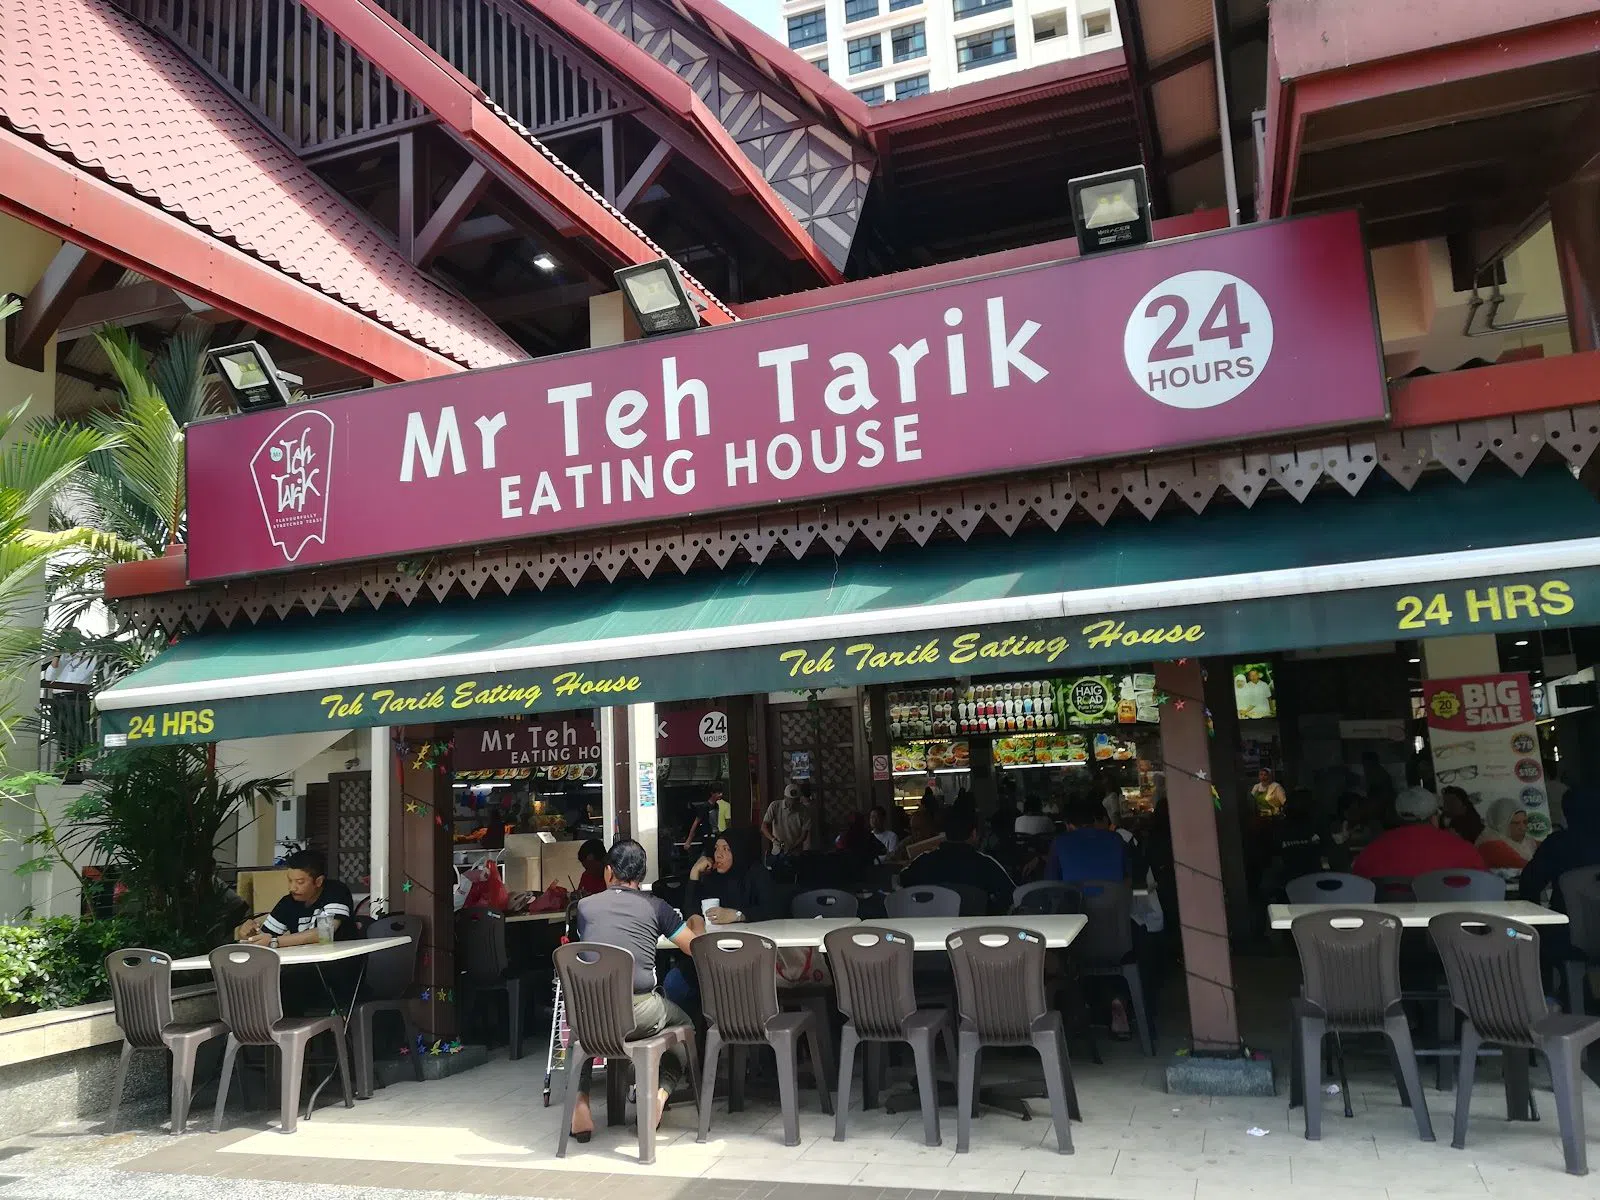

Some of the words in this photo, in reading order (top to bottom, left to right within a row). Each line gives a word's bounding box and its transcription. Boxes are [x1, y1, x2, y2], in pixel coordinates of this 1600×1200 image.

[1144, 282, 1251, 363] 24
[399, 405, 508, 482] Mr
[547, 356, 711, 457] Teh
[757, 295, 1050, 424] Tarik
[1147, 356, 1255, 392] HOURS
[500, 449, 696, 519] EATING
[725, 413, 923, 487] HOUSE
[1396, 593, 1452, 630] 24
[1466, 580, 1574, 623] HRS
[779, 647, 834, 677] Teh
[847, 640, 939, 671] Tarik
[948, 633, 1067, 664] Eating
[1082, 620, 1205, 648] House
[320, 693, 364, 718] Teh
[371, 687, 445, 714] Tarik
[450, 681, 542, 709] Eating
[552, 671, 640, 697] House
[1076, 685, 1102, 697] HAIG
[1076, 694, 1104, 706] ROAD
[1440, 700, 1452, 710] 20
[1462, 680, 1521, 709] BIG
[127, 715, 156, 740] 24
[162, 709, 215, 737] HRS
[703, 716, 727, 735] 24
[1466, 704, 1524, 726] SALE
[481, 729, 515, 752] Mr
[528, 721, 577, 748] Teh
[703, 734, 727, 742] HOURS
[511, 747, 570, 764] EATING
